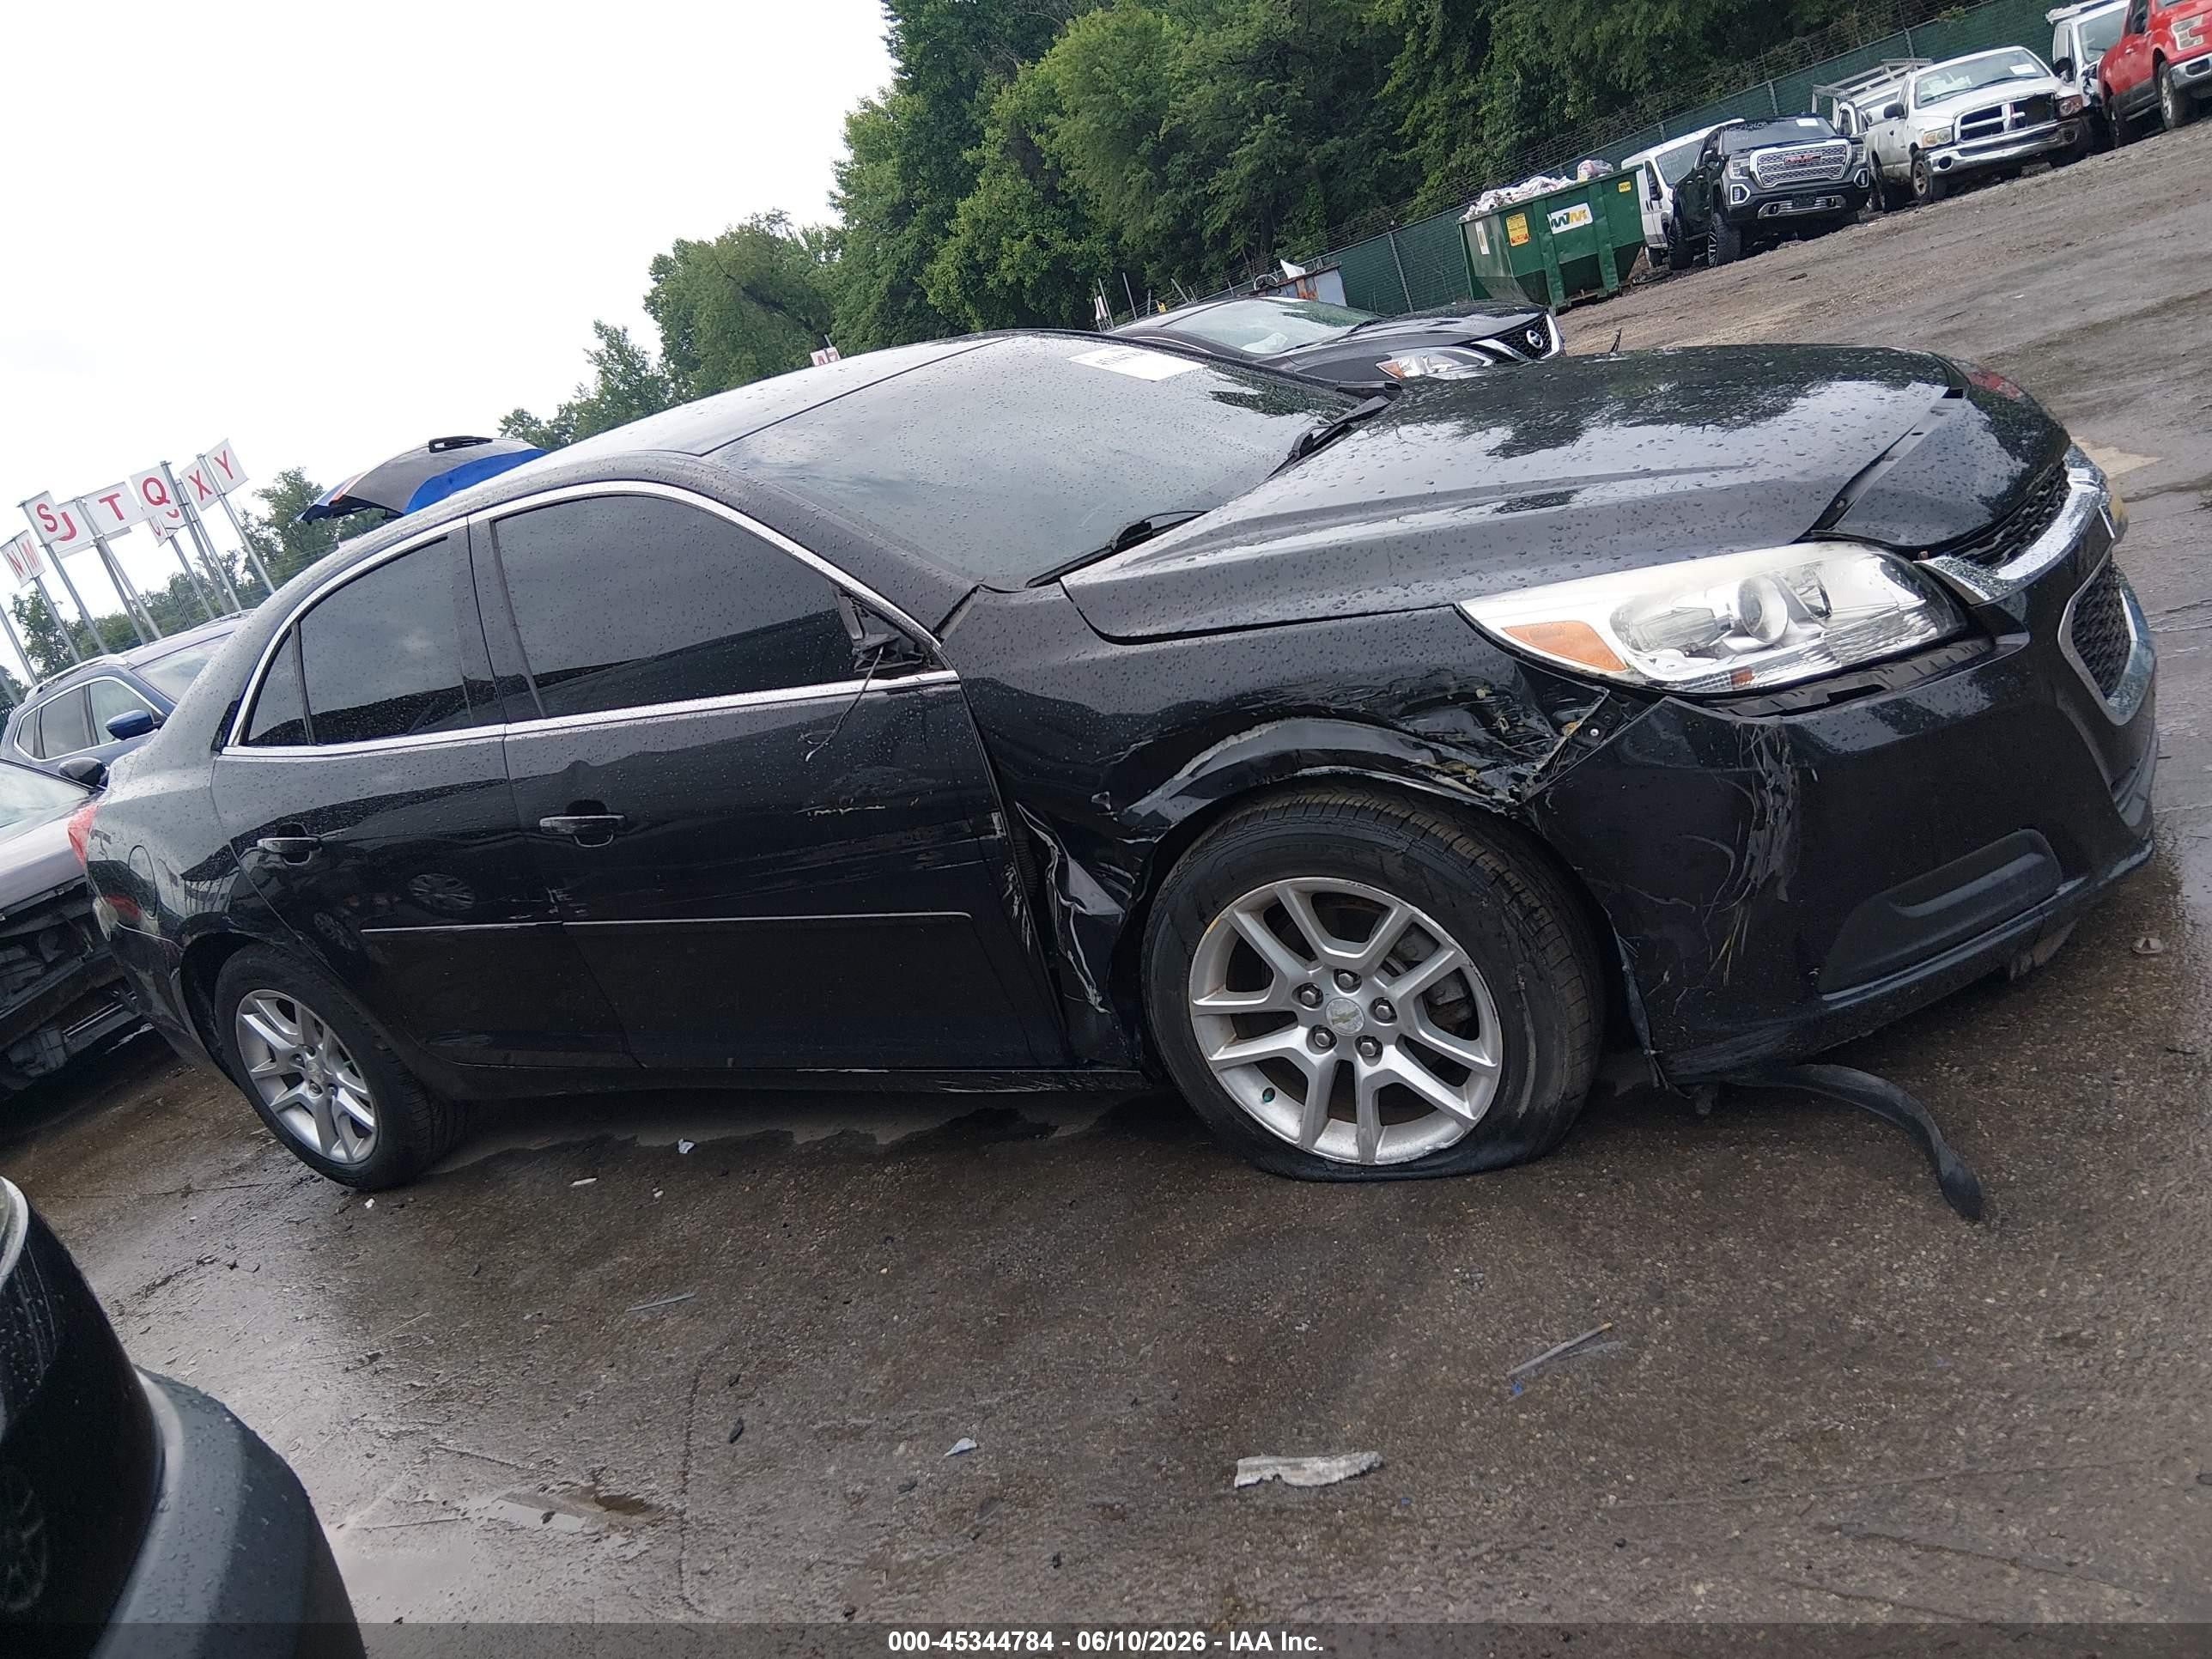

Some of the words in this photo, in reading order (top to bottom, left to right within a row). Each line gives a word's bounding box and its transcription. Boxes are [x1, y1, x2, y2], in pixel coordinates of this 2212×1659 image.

[214, 450, 234, 480] Y
[142, 477, 171, 507] Q
[188, 470, 212, 501] X
[36, 502, 58, 532] S
[98, 492, 125, 521] T
[58, 511, 77, 542] J
[7, 550, 26, 579] N
[21, 538, 40, 570] M
